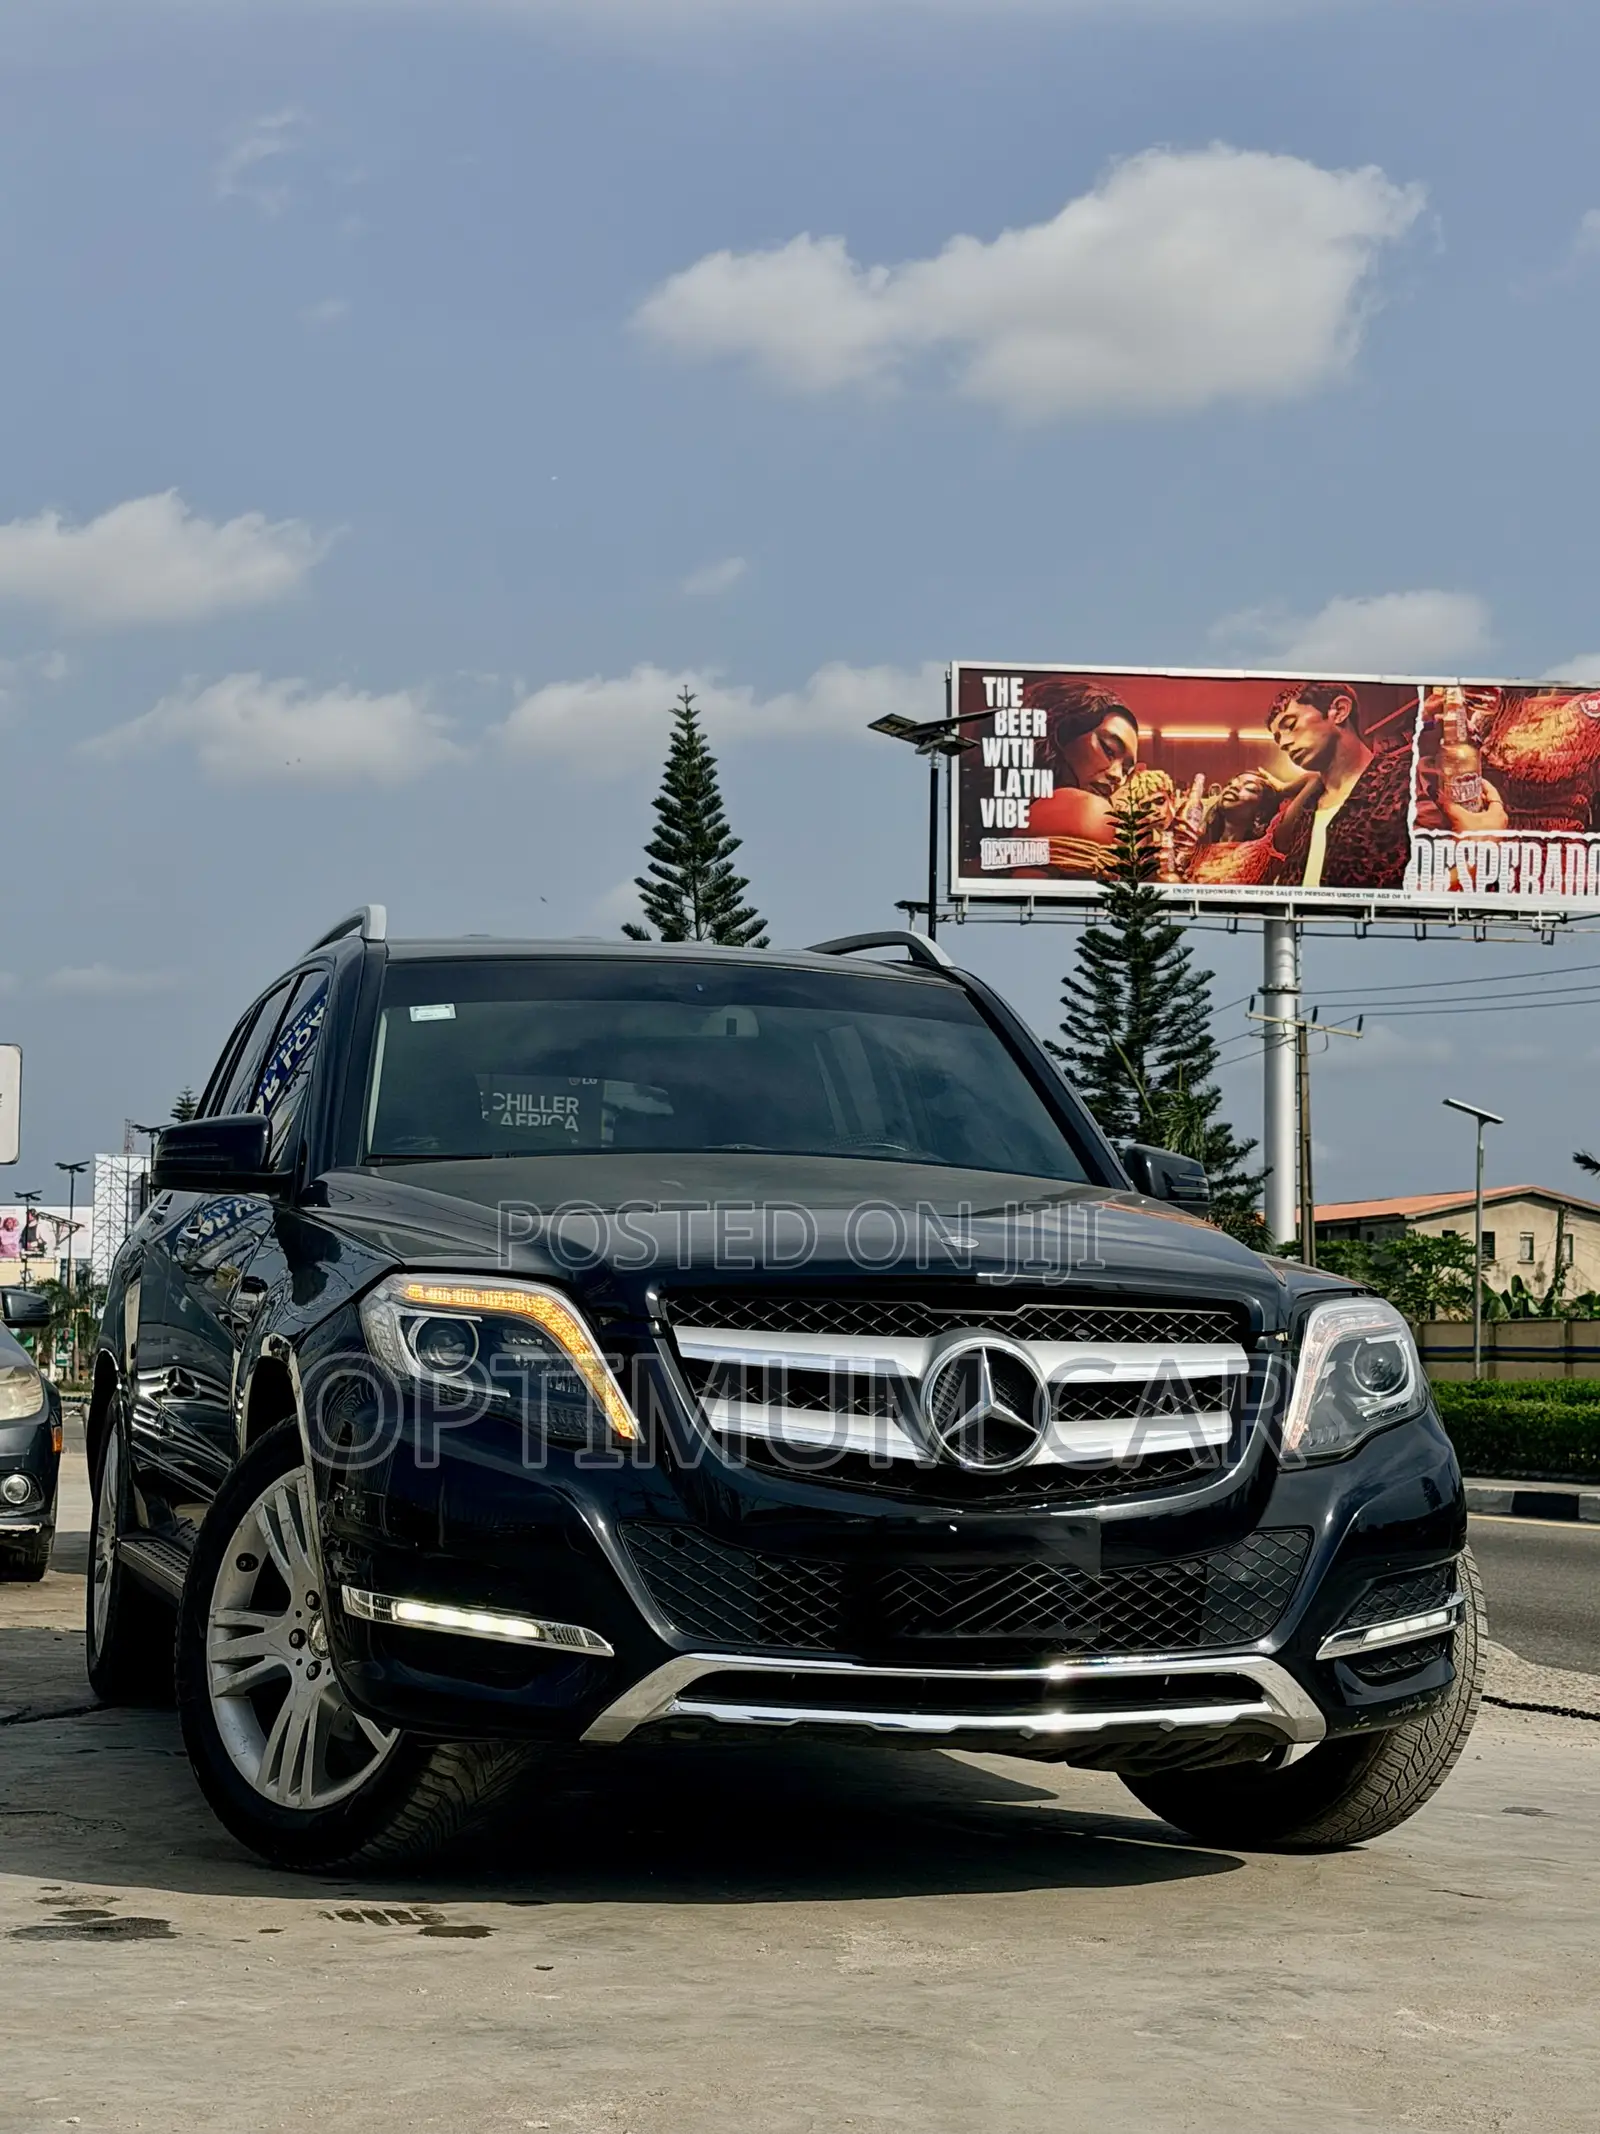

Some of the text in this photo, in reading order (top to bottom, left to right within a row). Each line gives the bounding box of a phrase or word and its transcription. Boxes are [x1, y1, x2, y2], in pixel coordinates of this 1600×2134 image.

[982, 676, 1024, 708] THE
[994, 708, 1048, 738] BEER
[982, 737, 1035, 768] WITH
[993, 768, 1055, 799] LATIN
[980, 798, 1031, 829] VIBE
[982, 840, 1050, 867] DESPERADOS
[1304, 890, 1335, 898] PERSONS
